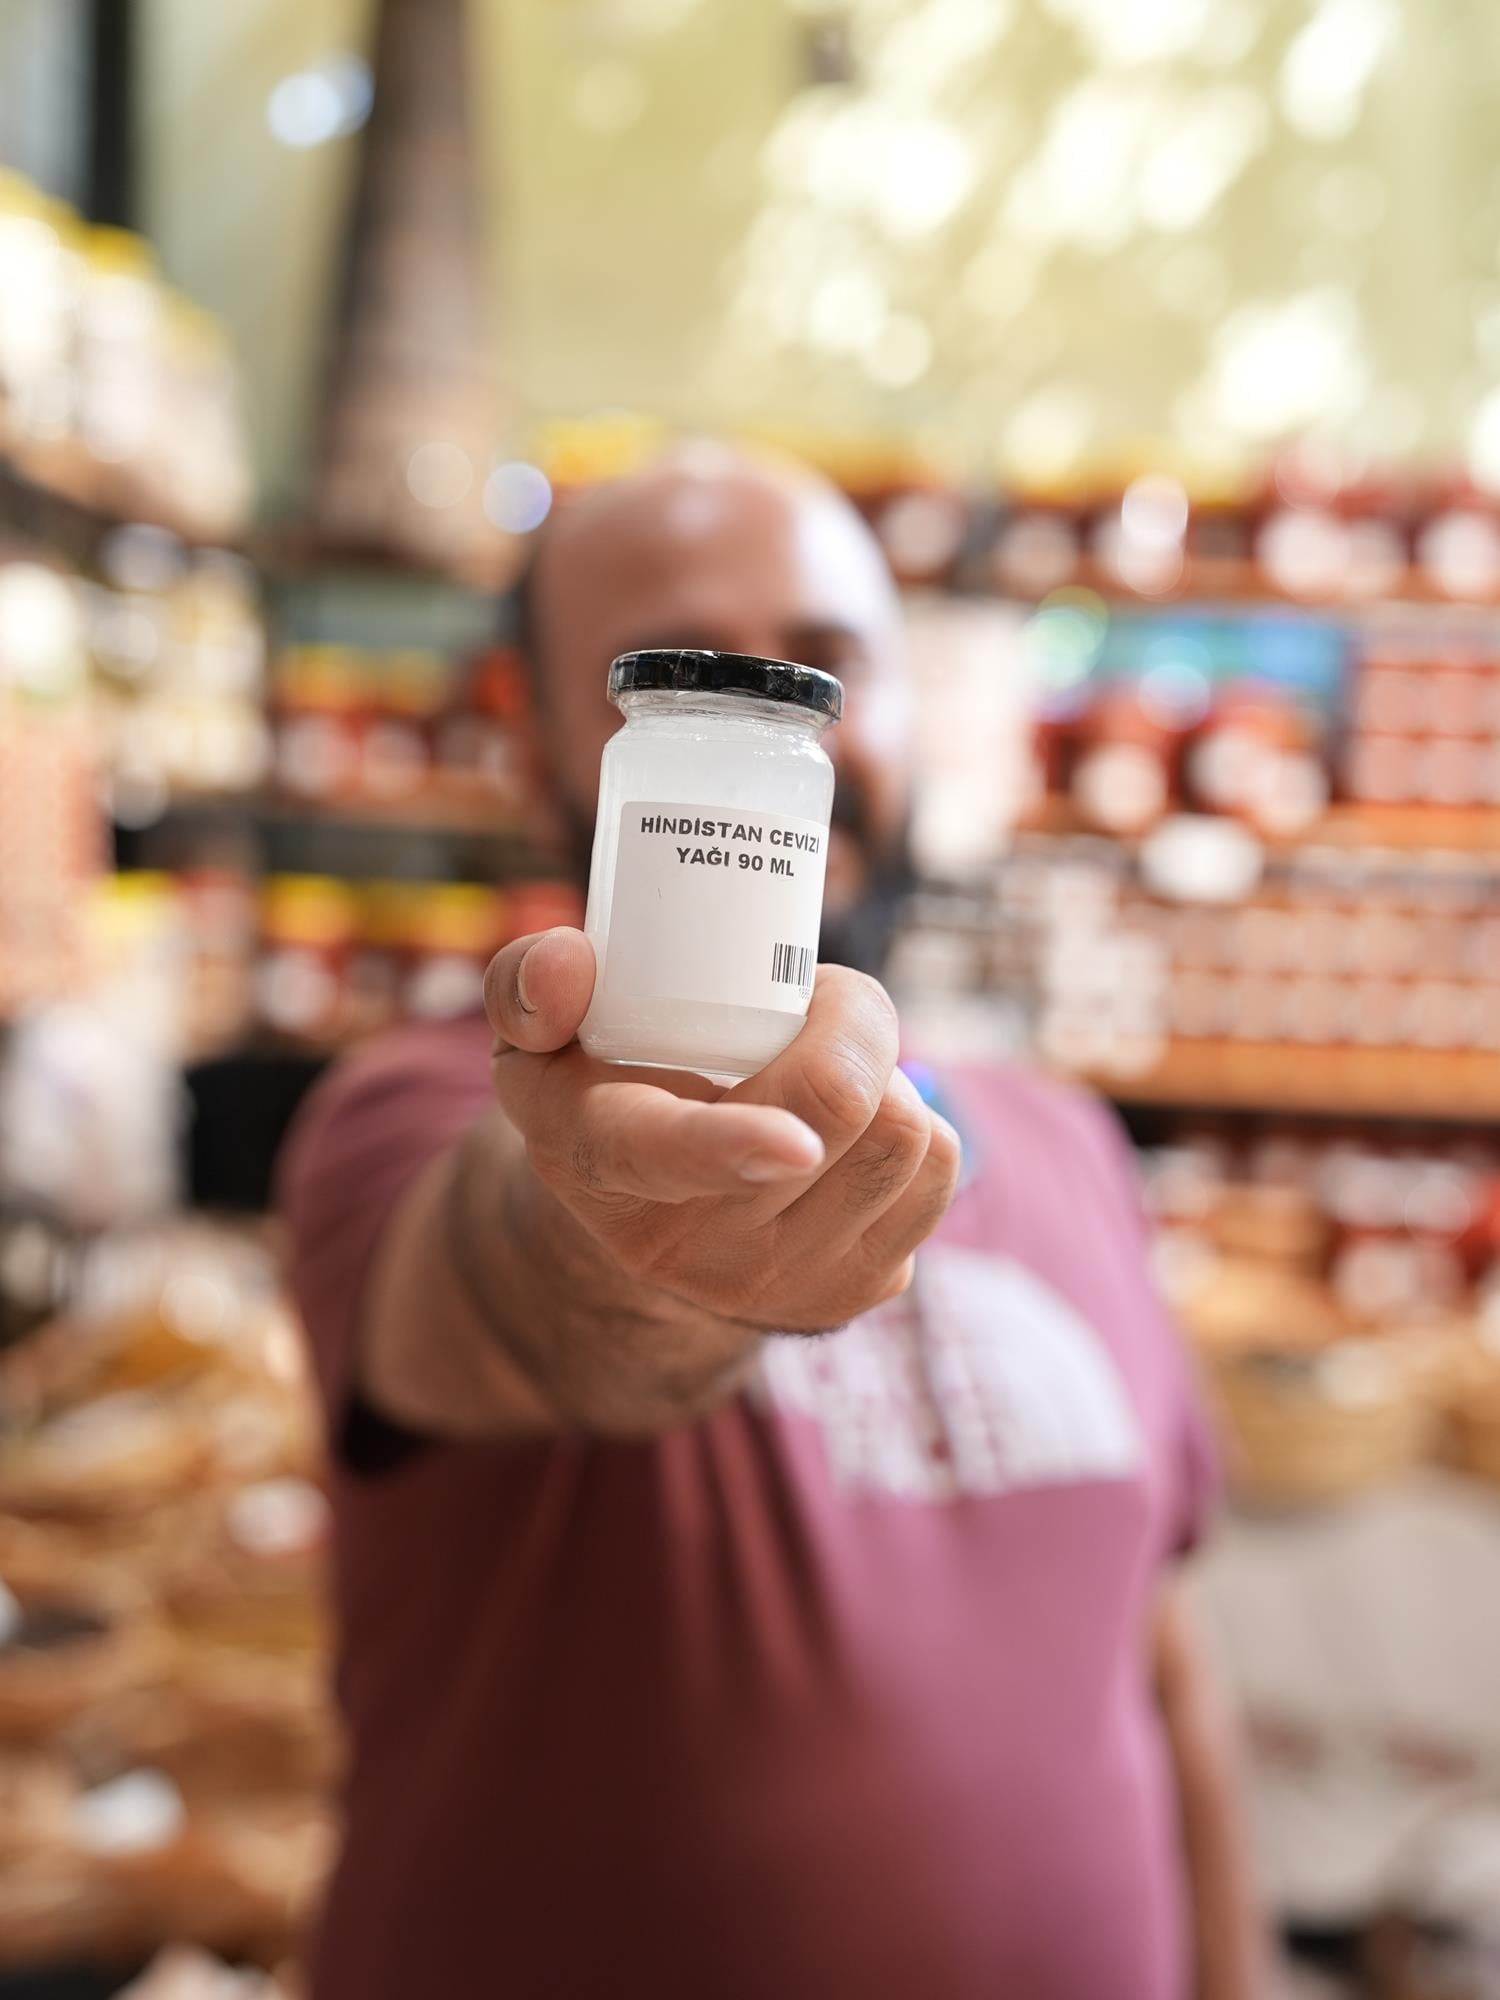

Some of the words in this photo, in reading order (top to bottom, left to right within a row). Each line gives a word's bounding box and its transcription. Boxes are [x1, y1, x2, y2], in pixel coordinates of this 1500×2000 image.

[641, 815, 762, 843] HİNDİSTAN
[770, 829, 820, 854] CEVİZİ
[676, 846, 730, 867] YAĞI
[738, 853, 763, 871] 90
[770, 857, 794, 877] ML
